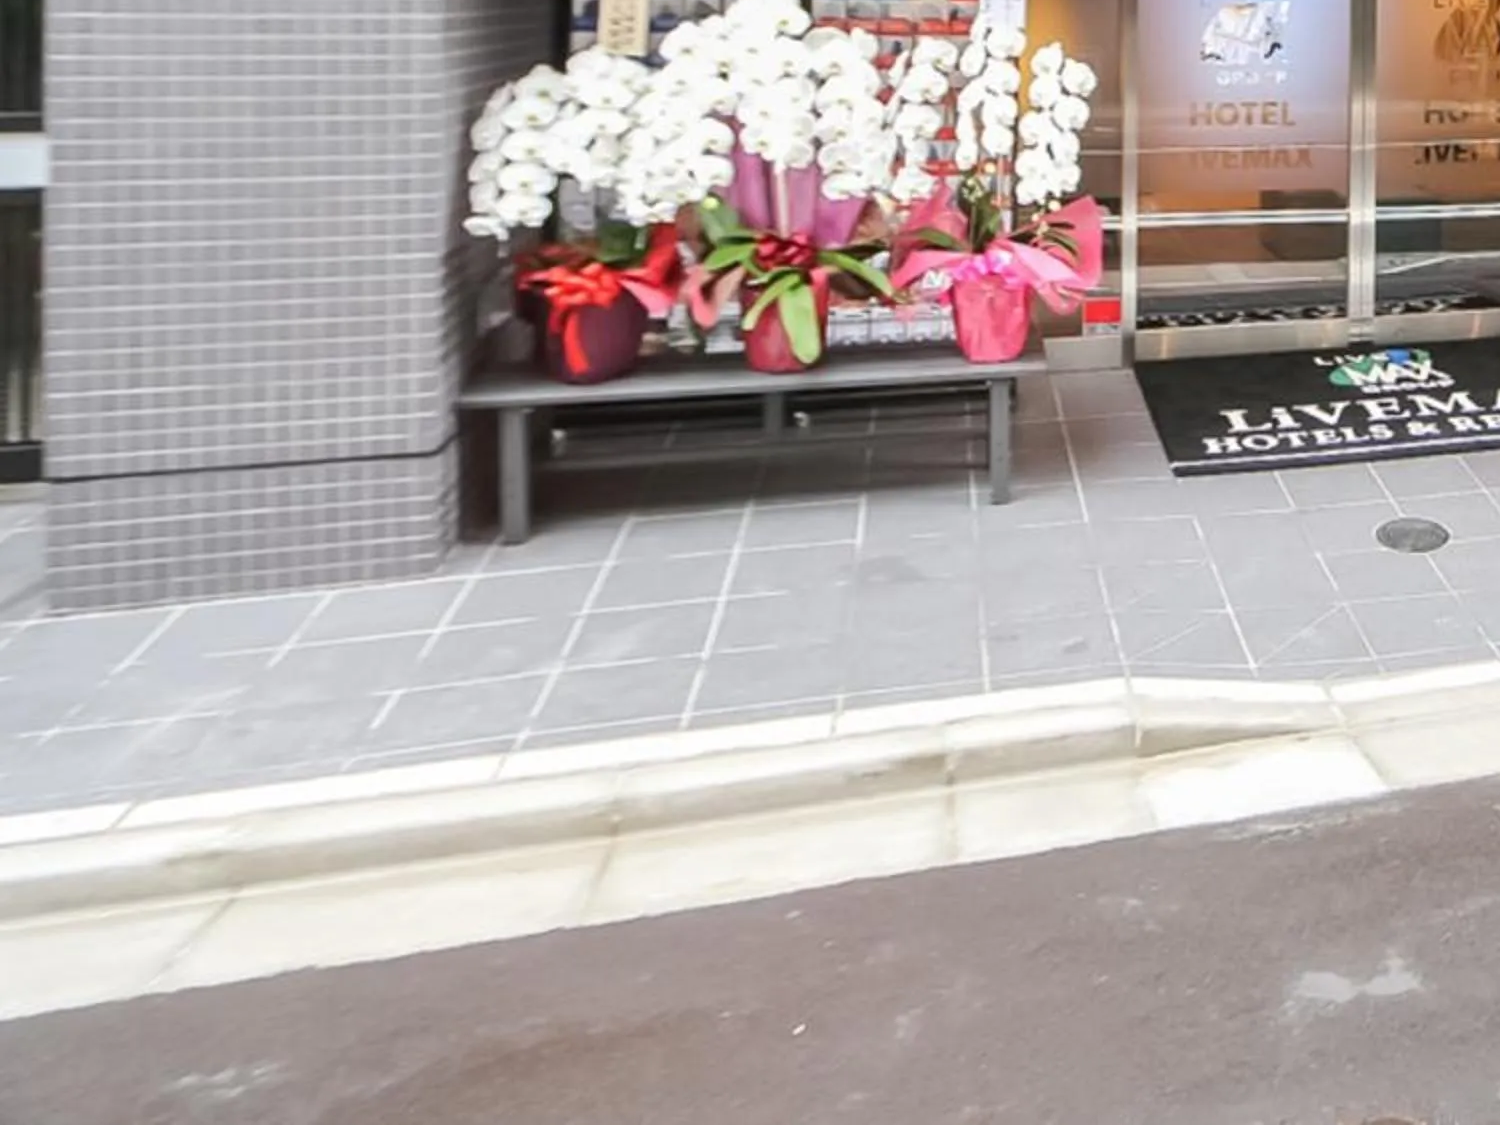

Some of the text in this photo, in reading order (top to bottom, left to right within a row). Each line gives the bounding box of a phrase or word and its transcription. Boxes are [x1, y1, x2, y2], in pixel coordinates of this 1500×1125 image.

[1189, 101, 1297, 127] HOTEL
[1202, 423, 1395, 455] HOTELS
[1407, 418, 1441, 437] &
